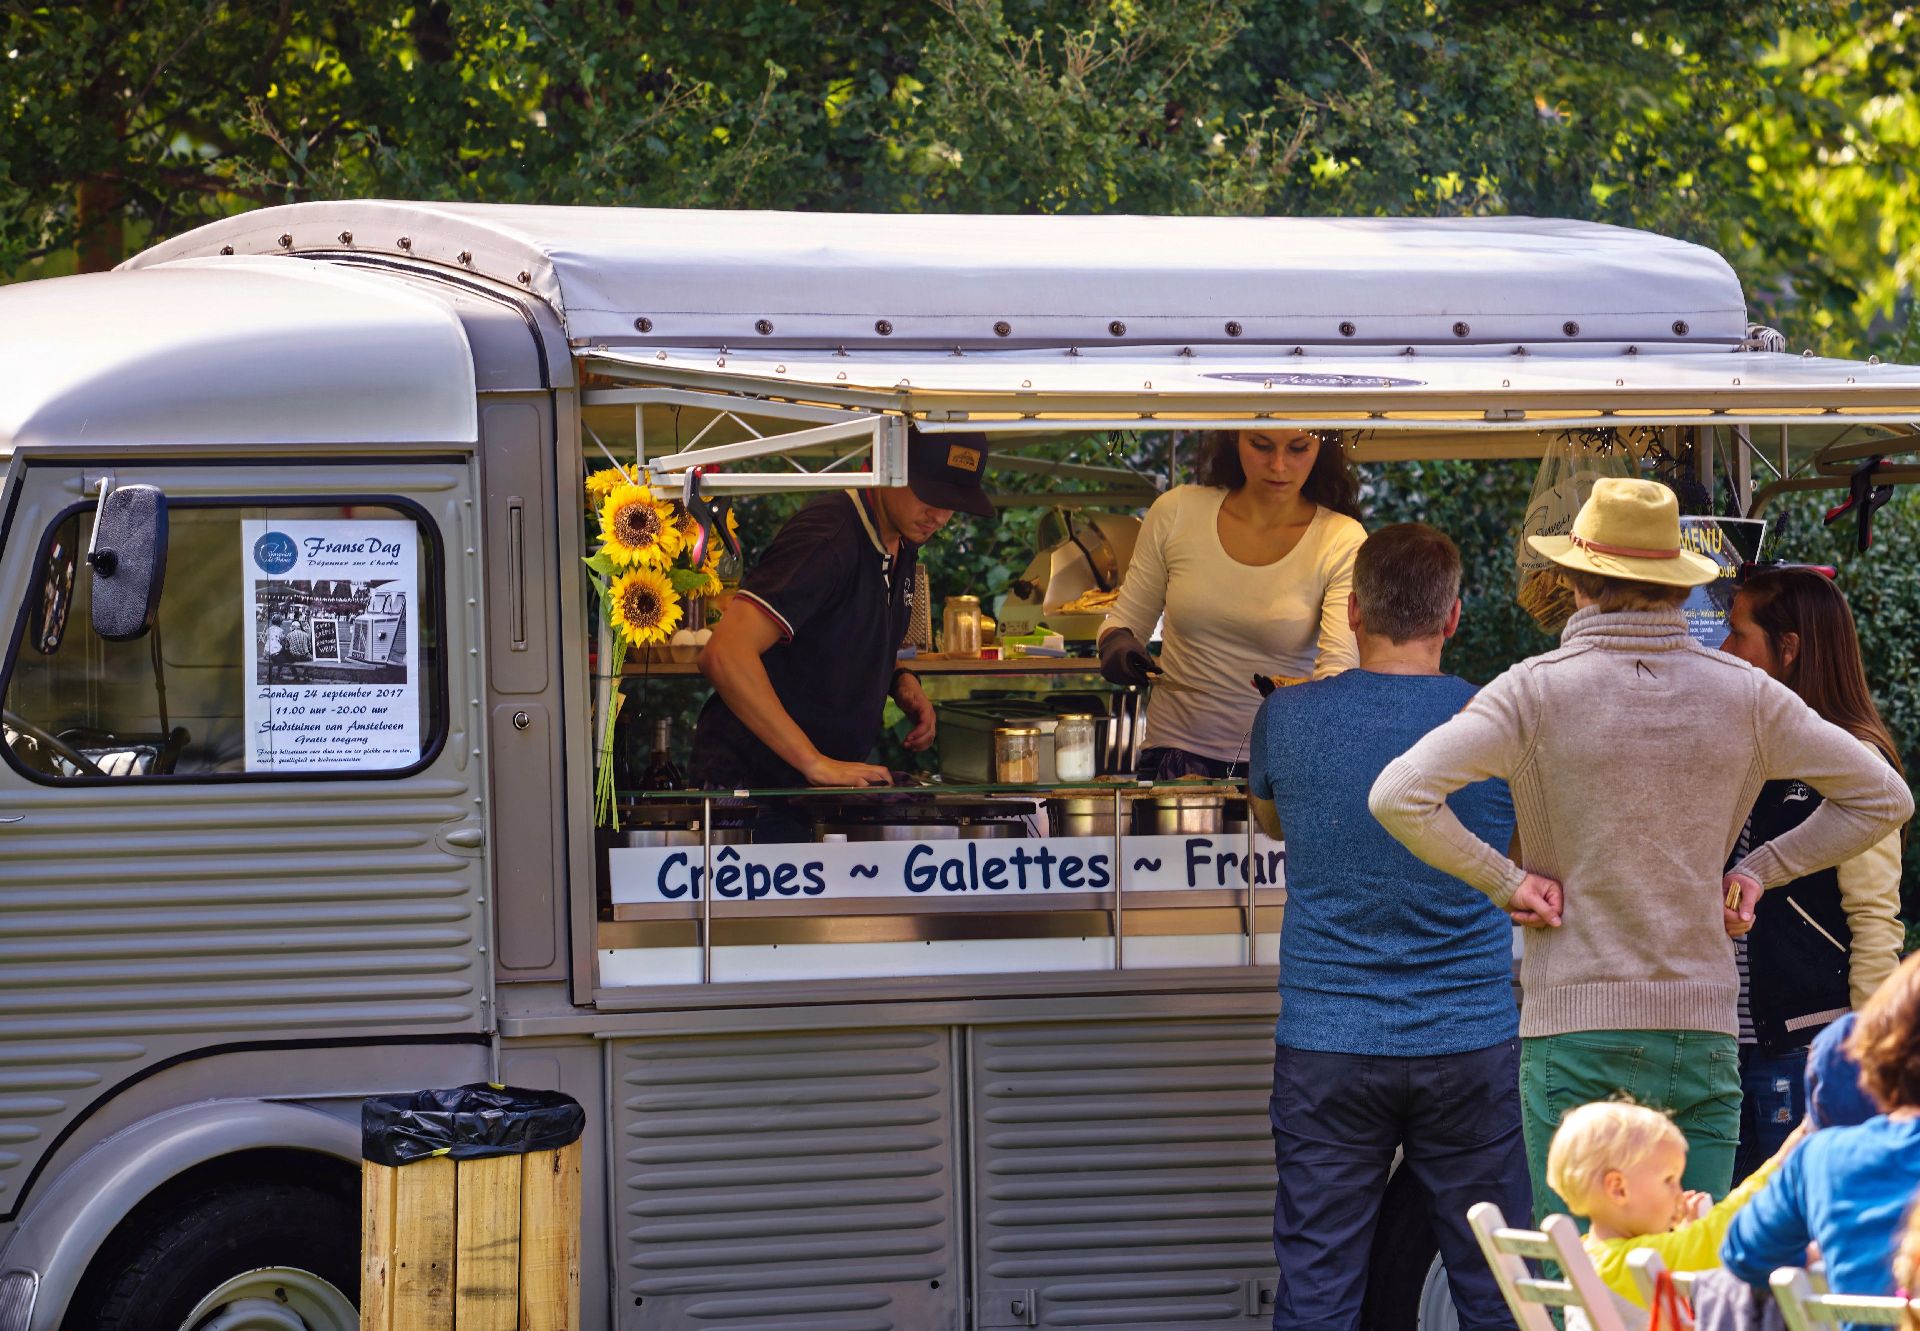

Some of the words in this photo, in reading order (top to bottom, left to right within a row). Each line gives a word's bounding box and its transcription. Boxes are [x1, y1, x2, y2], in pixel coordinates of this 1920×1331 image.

[303, 537, 364, 558] Franse
[365, 537, 401, 558] Dag
[1679, 527, 1722, 554] MENU
[1718, 562, 1737, 578] ouis
[259, 688, 299, 702] Zondag
[304, 689, 318, 698] 24
[322, 687, 372, 701] september
[376, 689, 403, 698] 2017
[275, 706, 305, 715] 11.00
[309, 706, 326, 714] uur
[371, 706, 388, 714] uur
[259, 720, 321, 733] Stadstuinen
[346, 720, 404, 732] Amstelveen
[294, 735, 327, 743] Gratis
[331, 736, 368, 744] toegang
[657, 845, 826, 901] Crêpes
[903, 841, 1111, 893] Galettes
[1186, 838, 1287, 888] Fran
